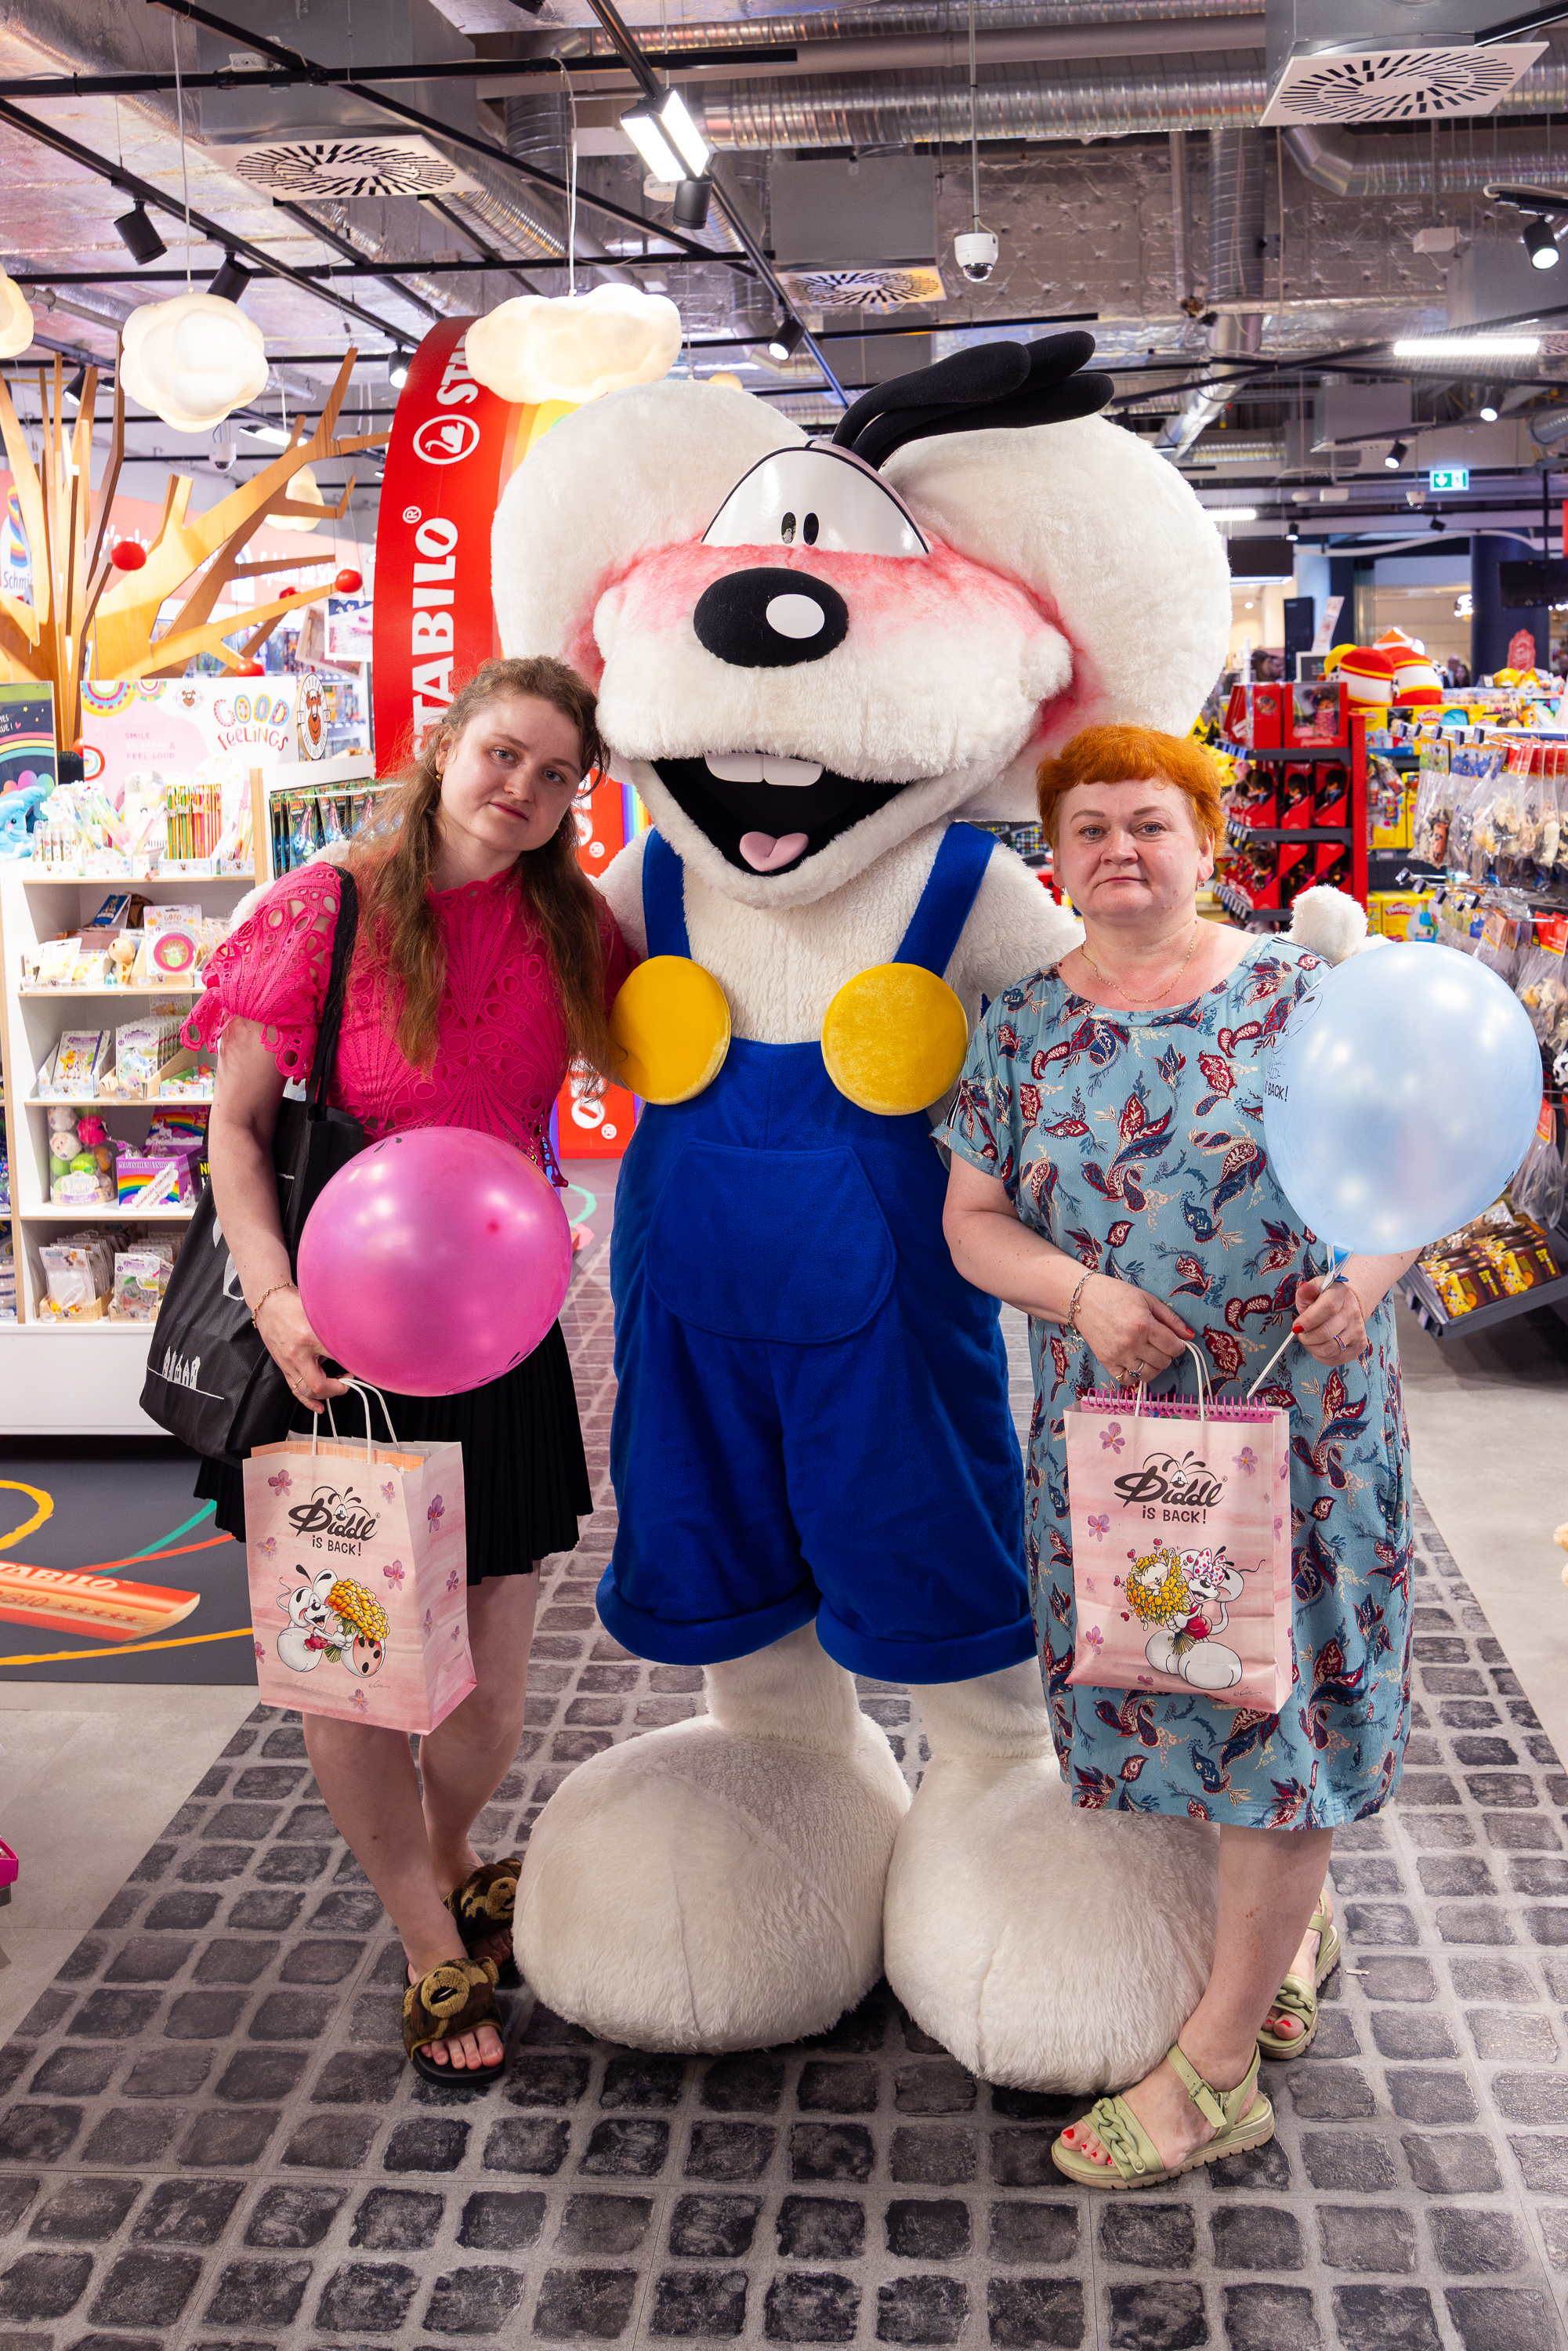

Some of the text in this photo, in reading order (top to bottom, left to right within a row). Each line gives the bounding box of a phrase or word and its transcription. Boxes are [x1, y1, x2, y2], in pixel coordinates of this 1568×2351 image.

[213, 694, 290, 727] GOOD
[1269, 1082, 1288, 1102] BACK!
[1114, 1465, 1227, 1508] Diddl
[288, 1497, 378, 1542] Diddl
[1163, 1509, 1207, 1524] BACK!
[328, 1539, 362, 1557] BACK!
[0, 1562, 118, 1590] TABILO
